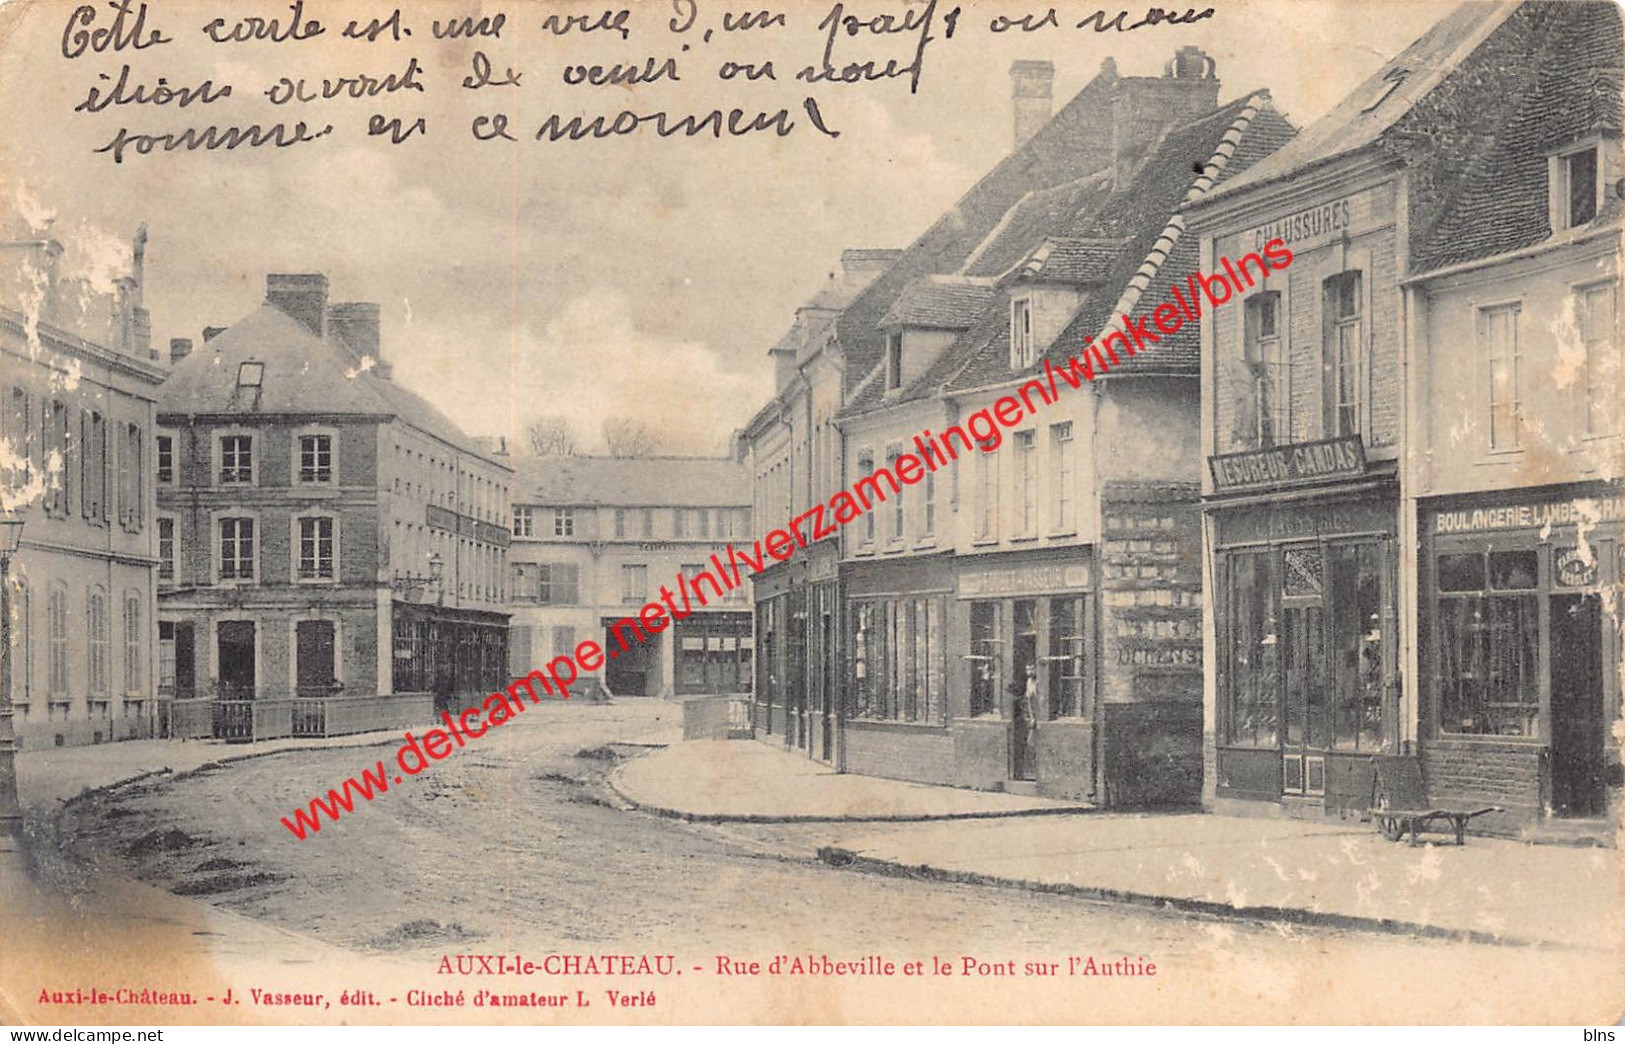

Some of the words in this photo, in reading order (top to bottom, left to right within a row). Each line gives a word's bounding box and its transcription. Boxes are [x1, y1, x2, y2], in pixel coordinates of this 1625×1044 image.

[61, 0, 173, 59] Cette
[432, 13, 506, 39] une
[1076, 7, 1215, 33] nous
[368, 114, 426, 144] en
[472, 114, 518, 141] ce
[1255, 199, 1351, 253] CHAUSSURES
[1213, 452, 1290, 484] MESUREUR
[1294, 441, 1359, 475] CANDAS
[1437, 505, 1531, 532] BOULANGERIE
